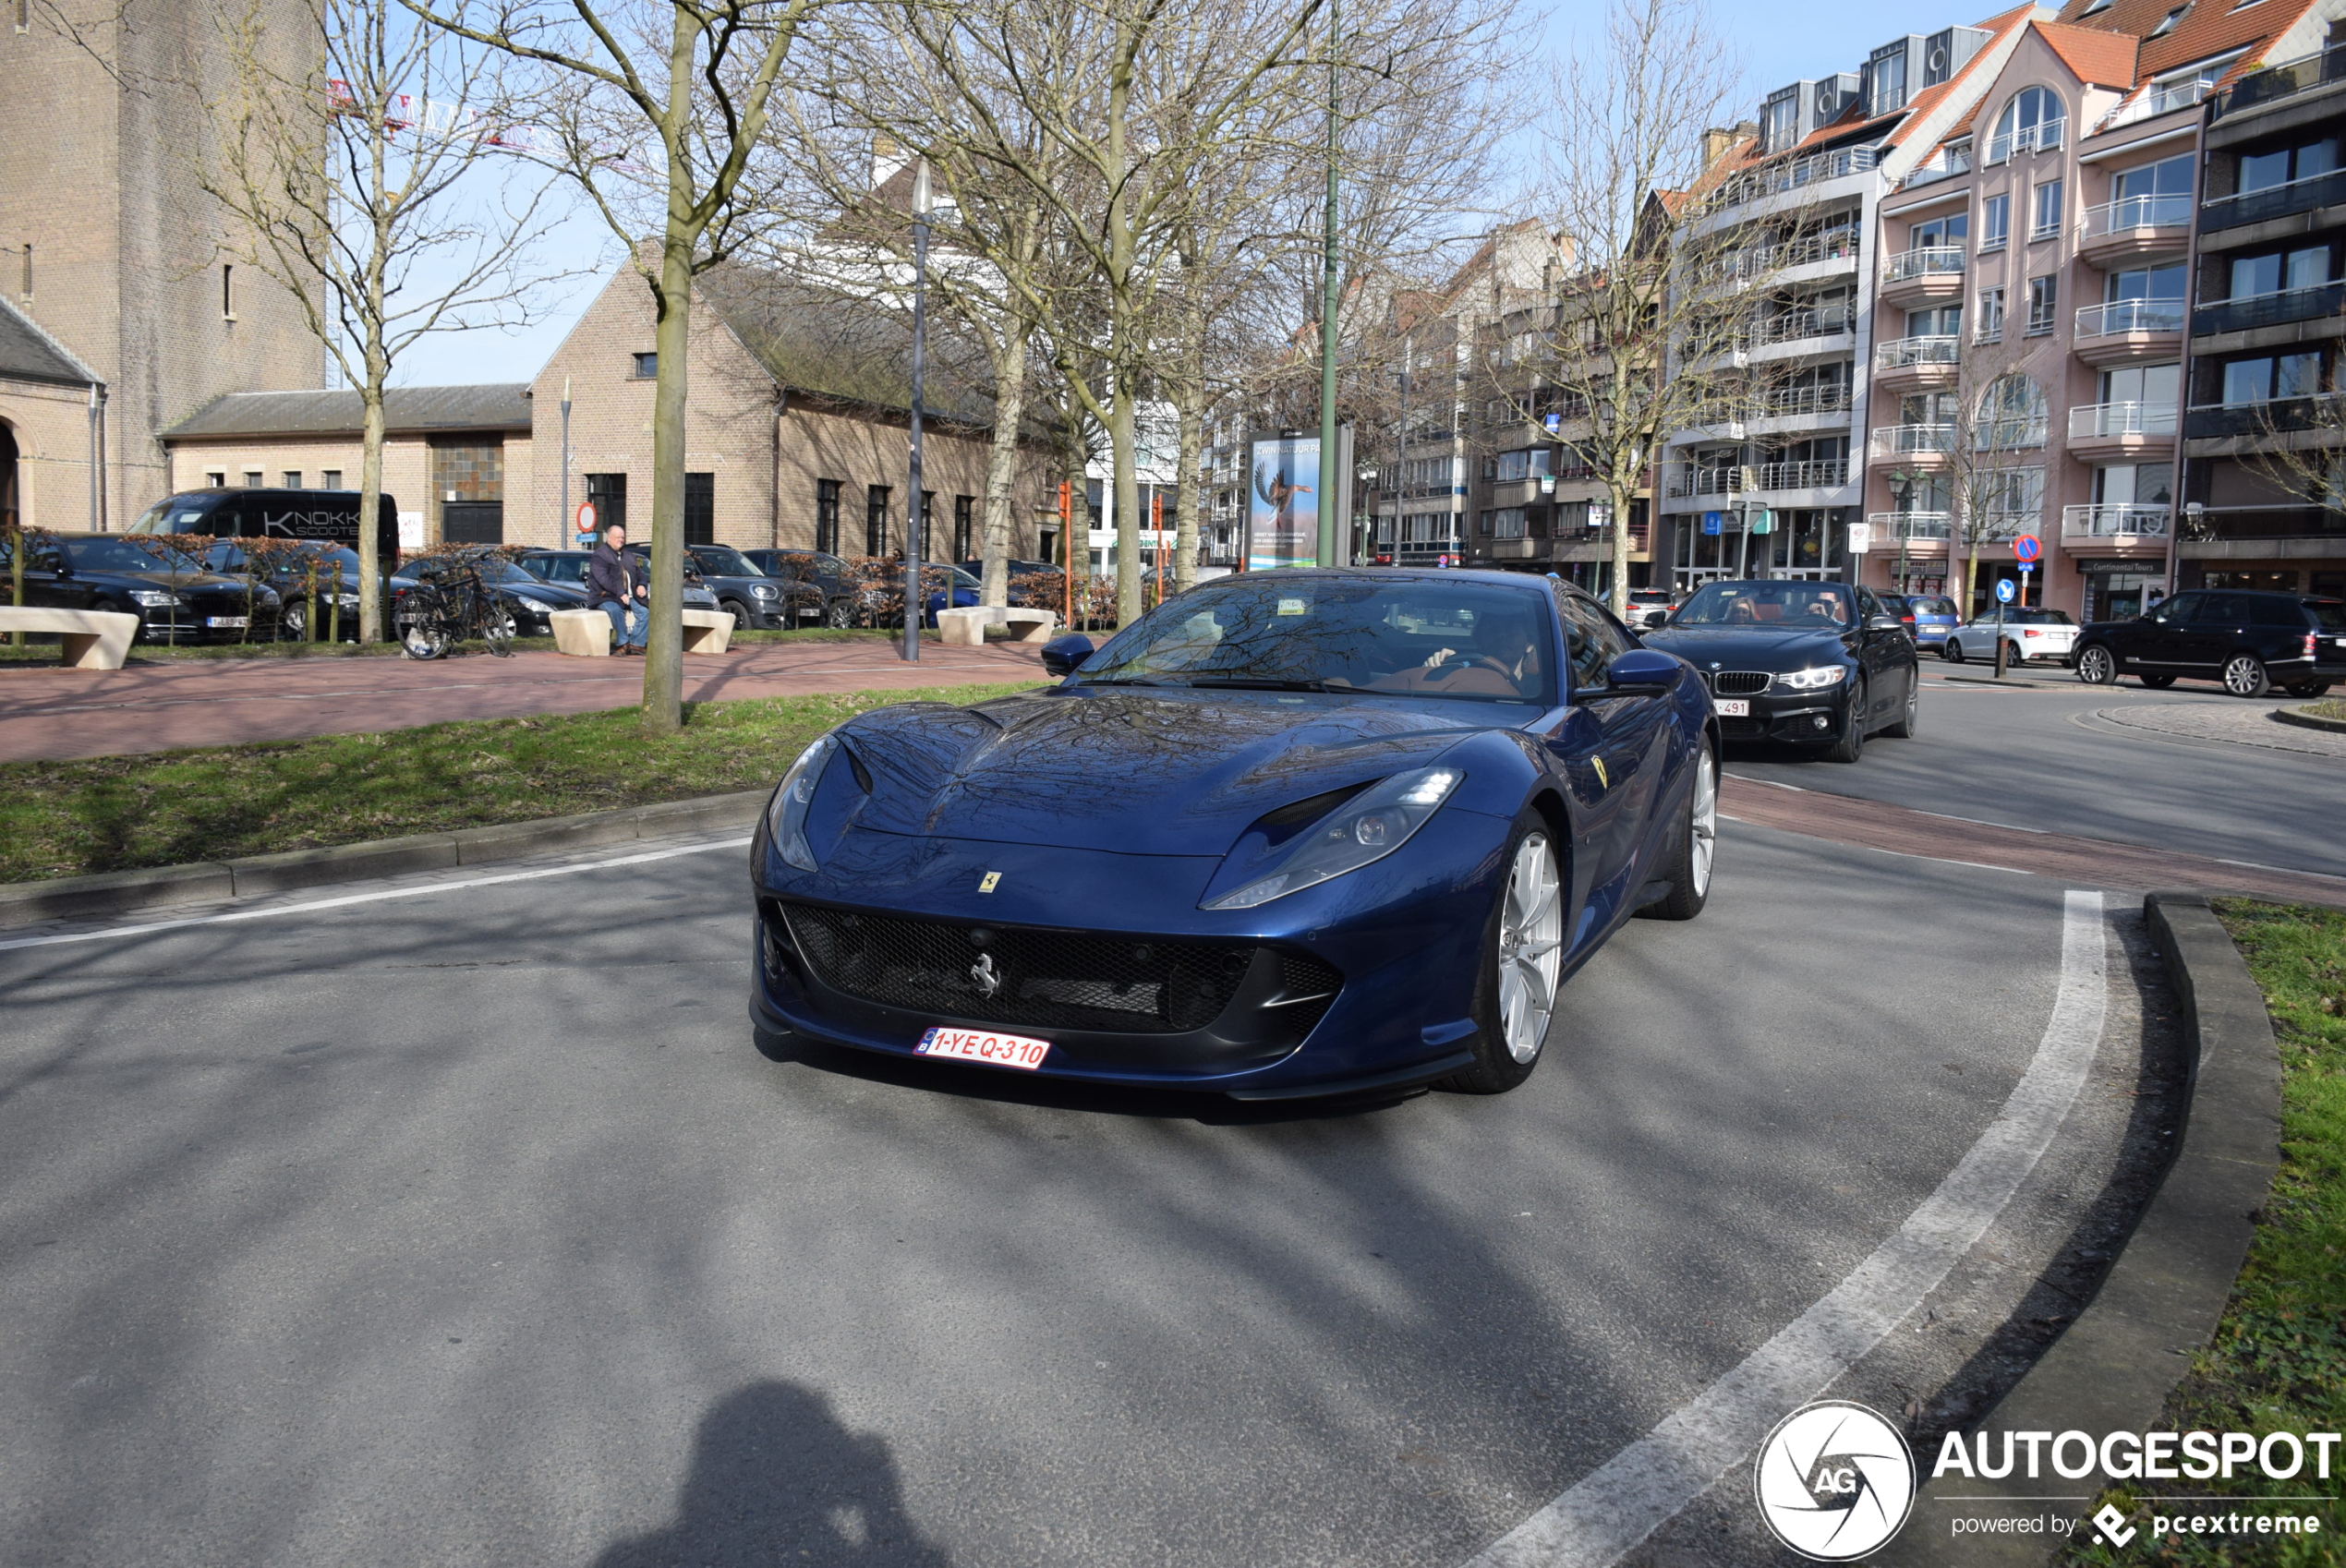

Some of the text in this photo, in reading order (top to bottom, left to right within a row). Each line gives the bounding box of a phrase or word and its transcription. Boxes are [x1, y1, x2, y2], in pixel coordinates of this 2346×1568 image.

[1257, 444, 1321, 455] ZWIN NATUUR PA
[264, 512, 360, 537] KNOKK
[296, 526, 360, 537] SCOOTE
[2093, 562, 2154, 572] Continental Tours
[917, 1031, 1044, 1064] B 1-YEQ-310
